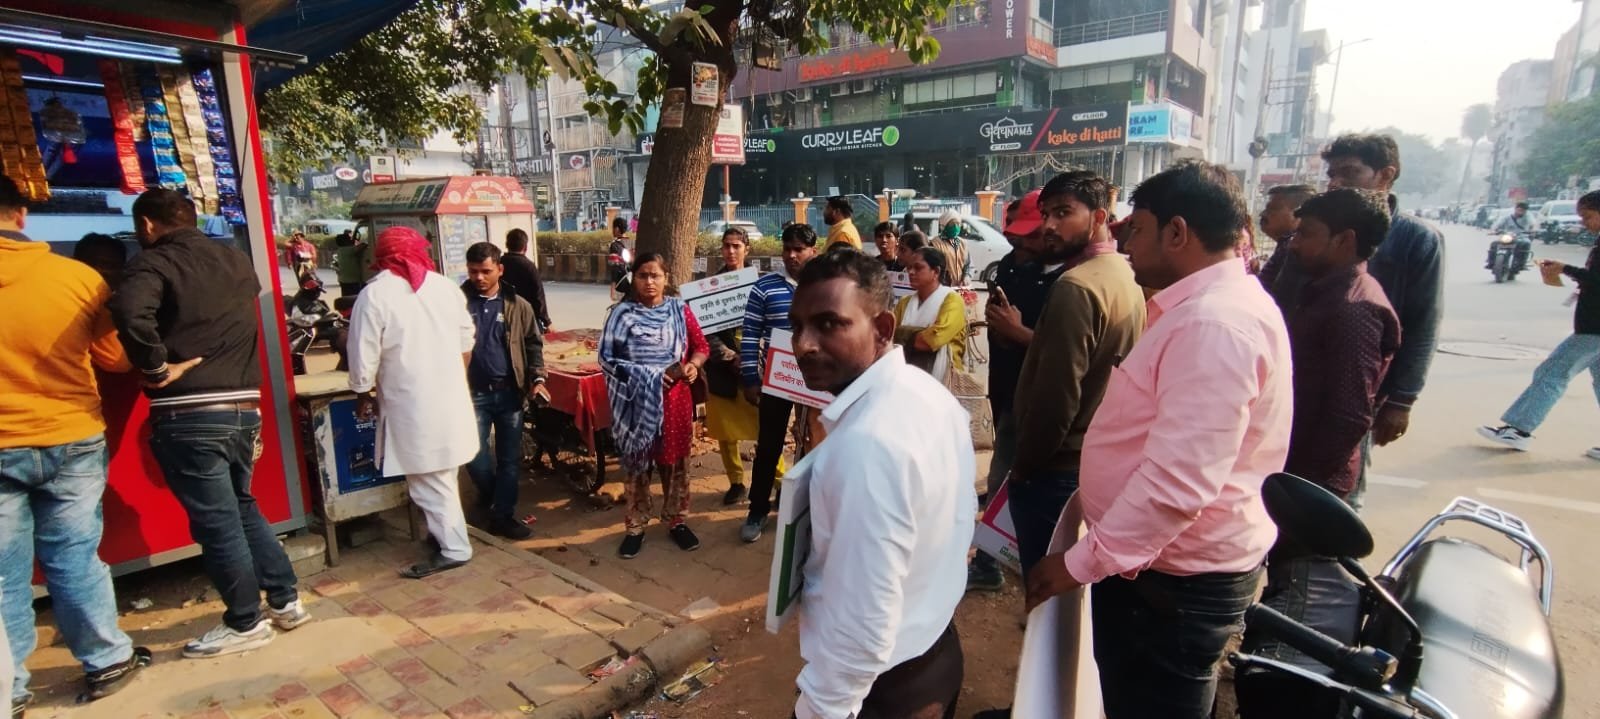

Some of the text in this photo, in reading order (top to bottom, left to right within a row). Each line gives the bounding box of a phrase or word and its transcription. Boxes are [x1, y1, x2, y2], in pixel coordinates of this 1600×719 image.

[1005, 0, 1014, 39] OWER
[1047, 126, 1122, 145] kake di hatti
[516, 159, 543, 175] RISHTI
